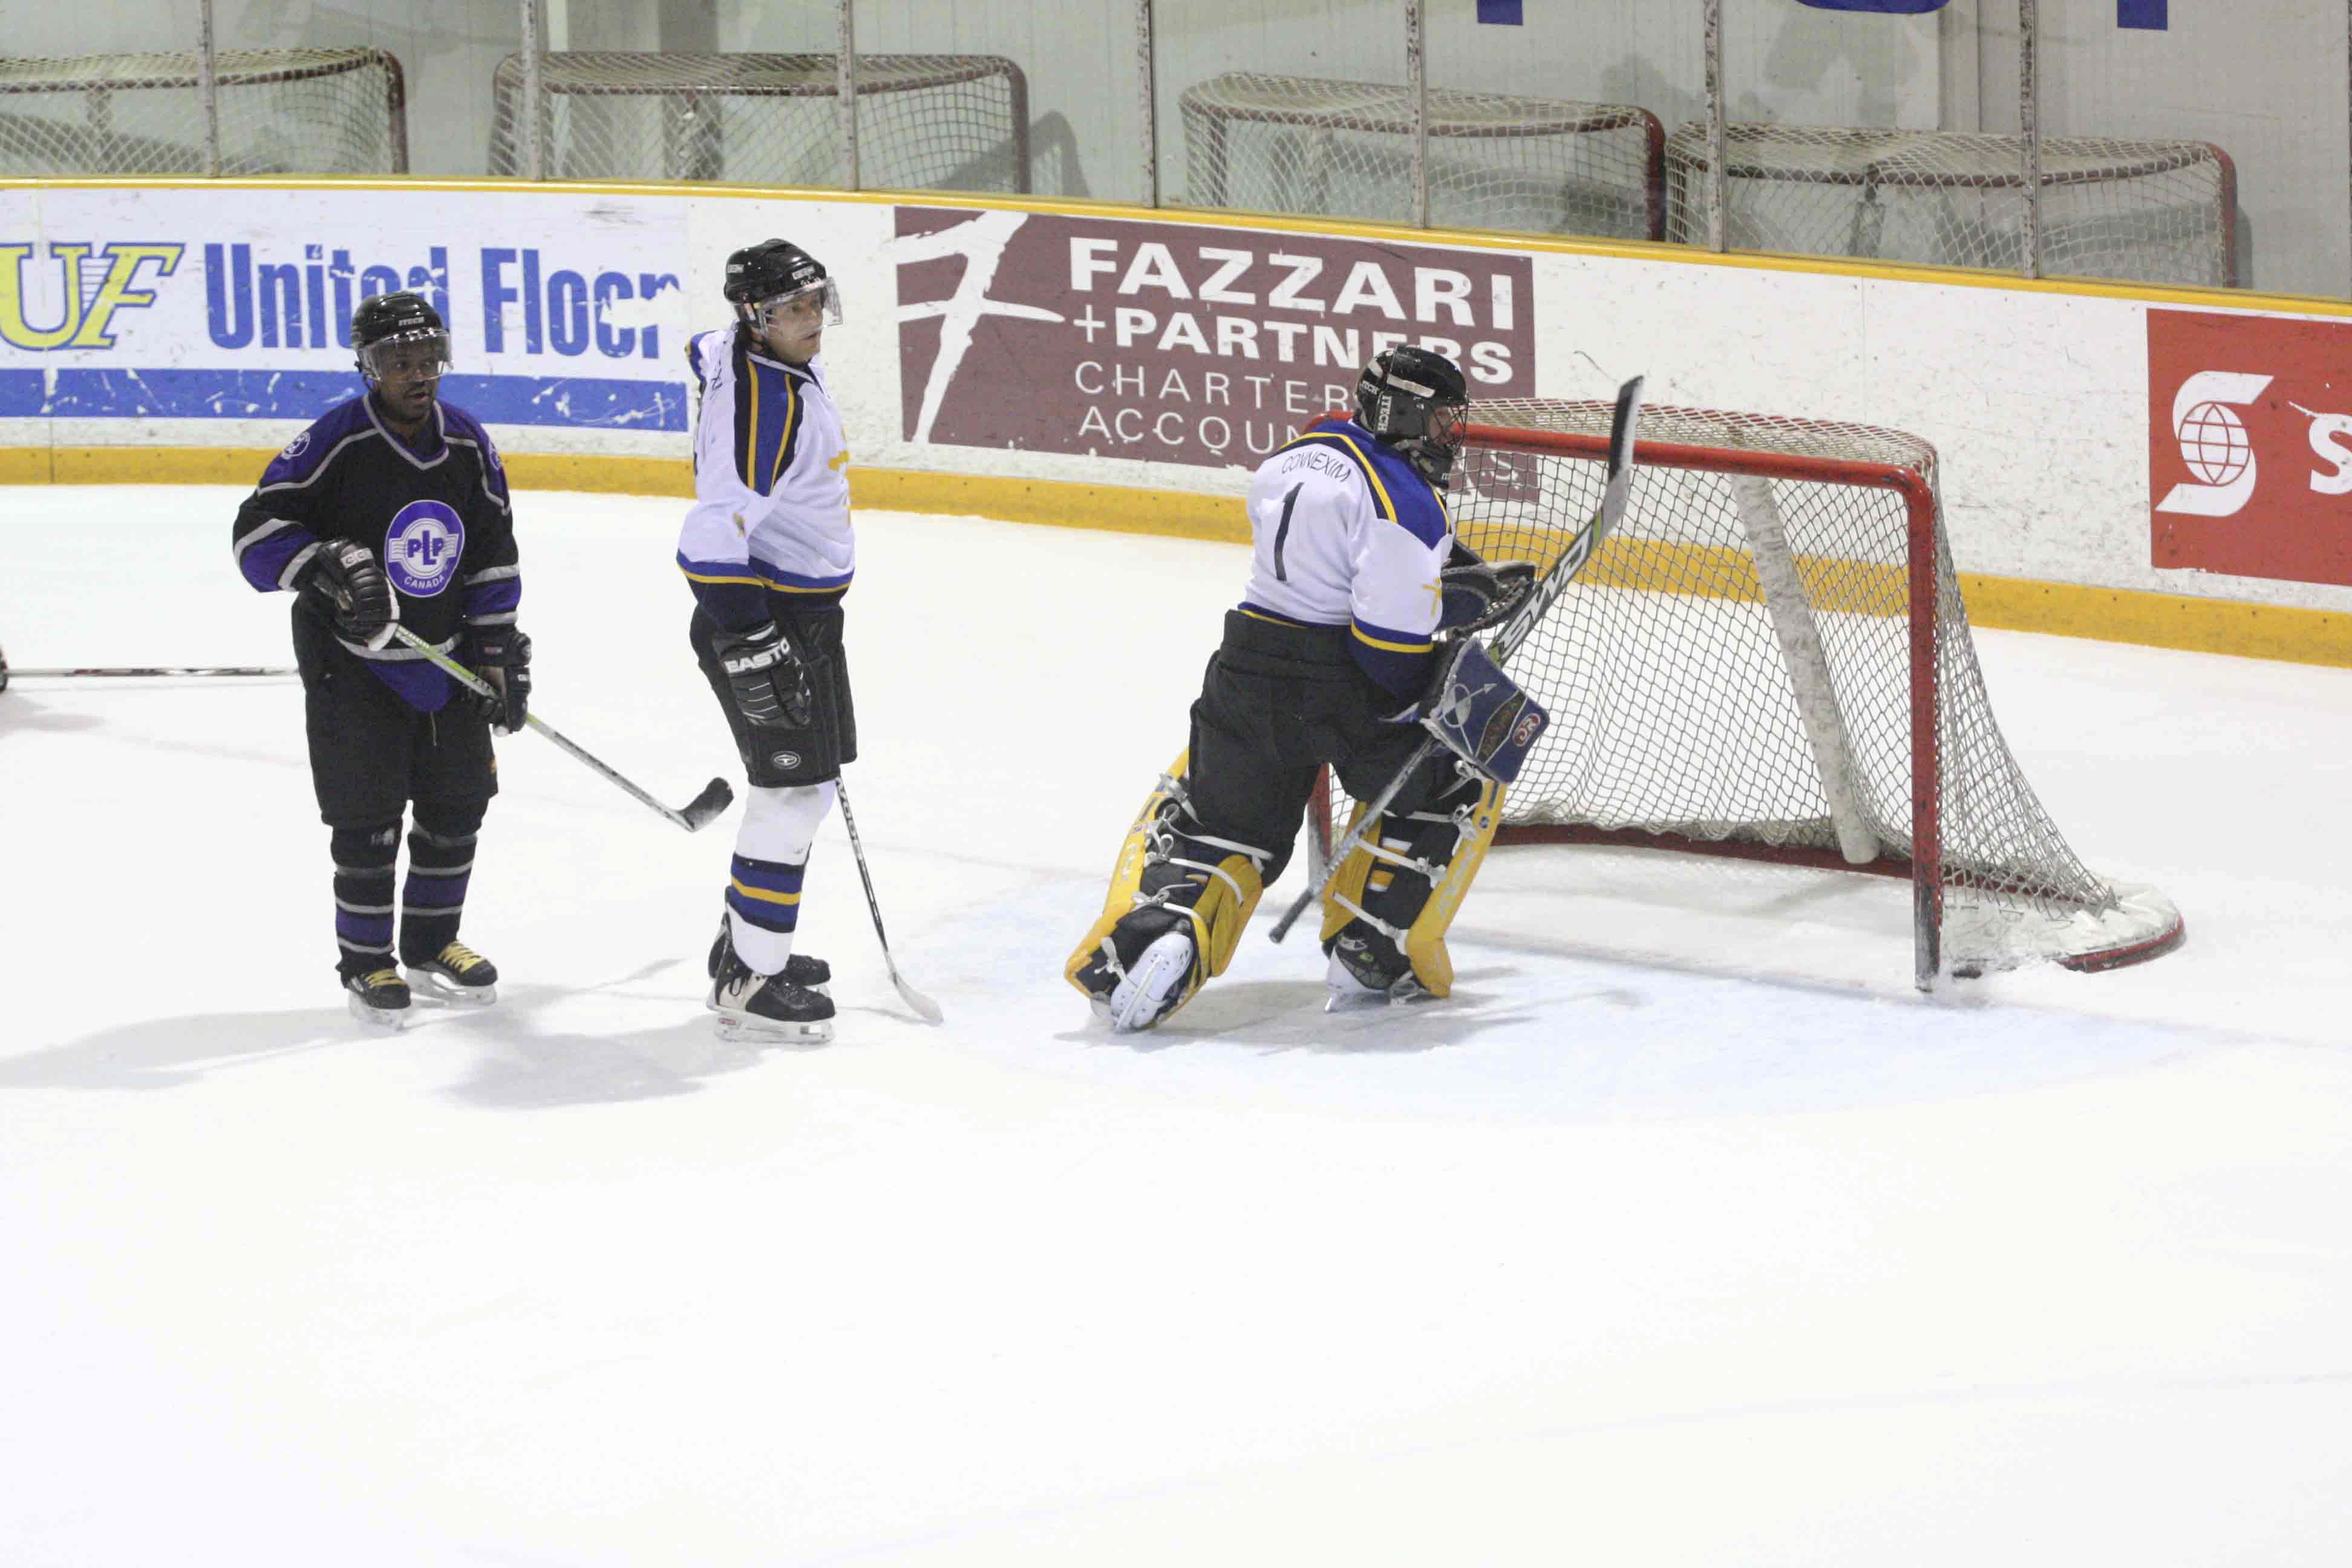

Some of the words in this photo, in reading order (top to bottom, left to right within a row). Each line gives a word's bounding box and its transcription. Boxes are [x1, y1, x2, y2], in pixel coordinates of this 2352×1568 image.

[1070, 236, 1514, 330] FAZZARI
[1377, 395, 1391, 432] ITECH
[407, 529, 445, 566] PLP
[1274, 482, 1305, 581] 1
[403, 574, 445, 589] CANADA
[724, 636, 791, 673] EASTO
